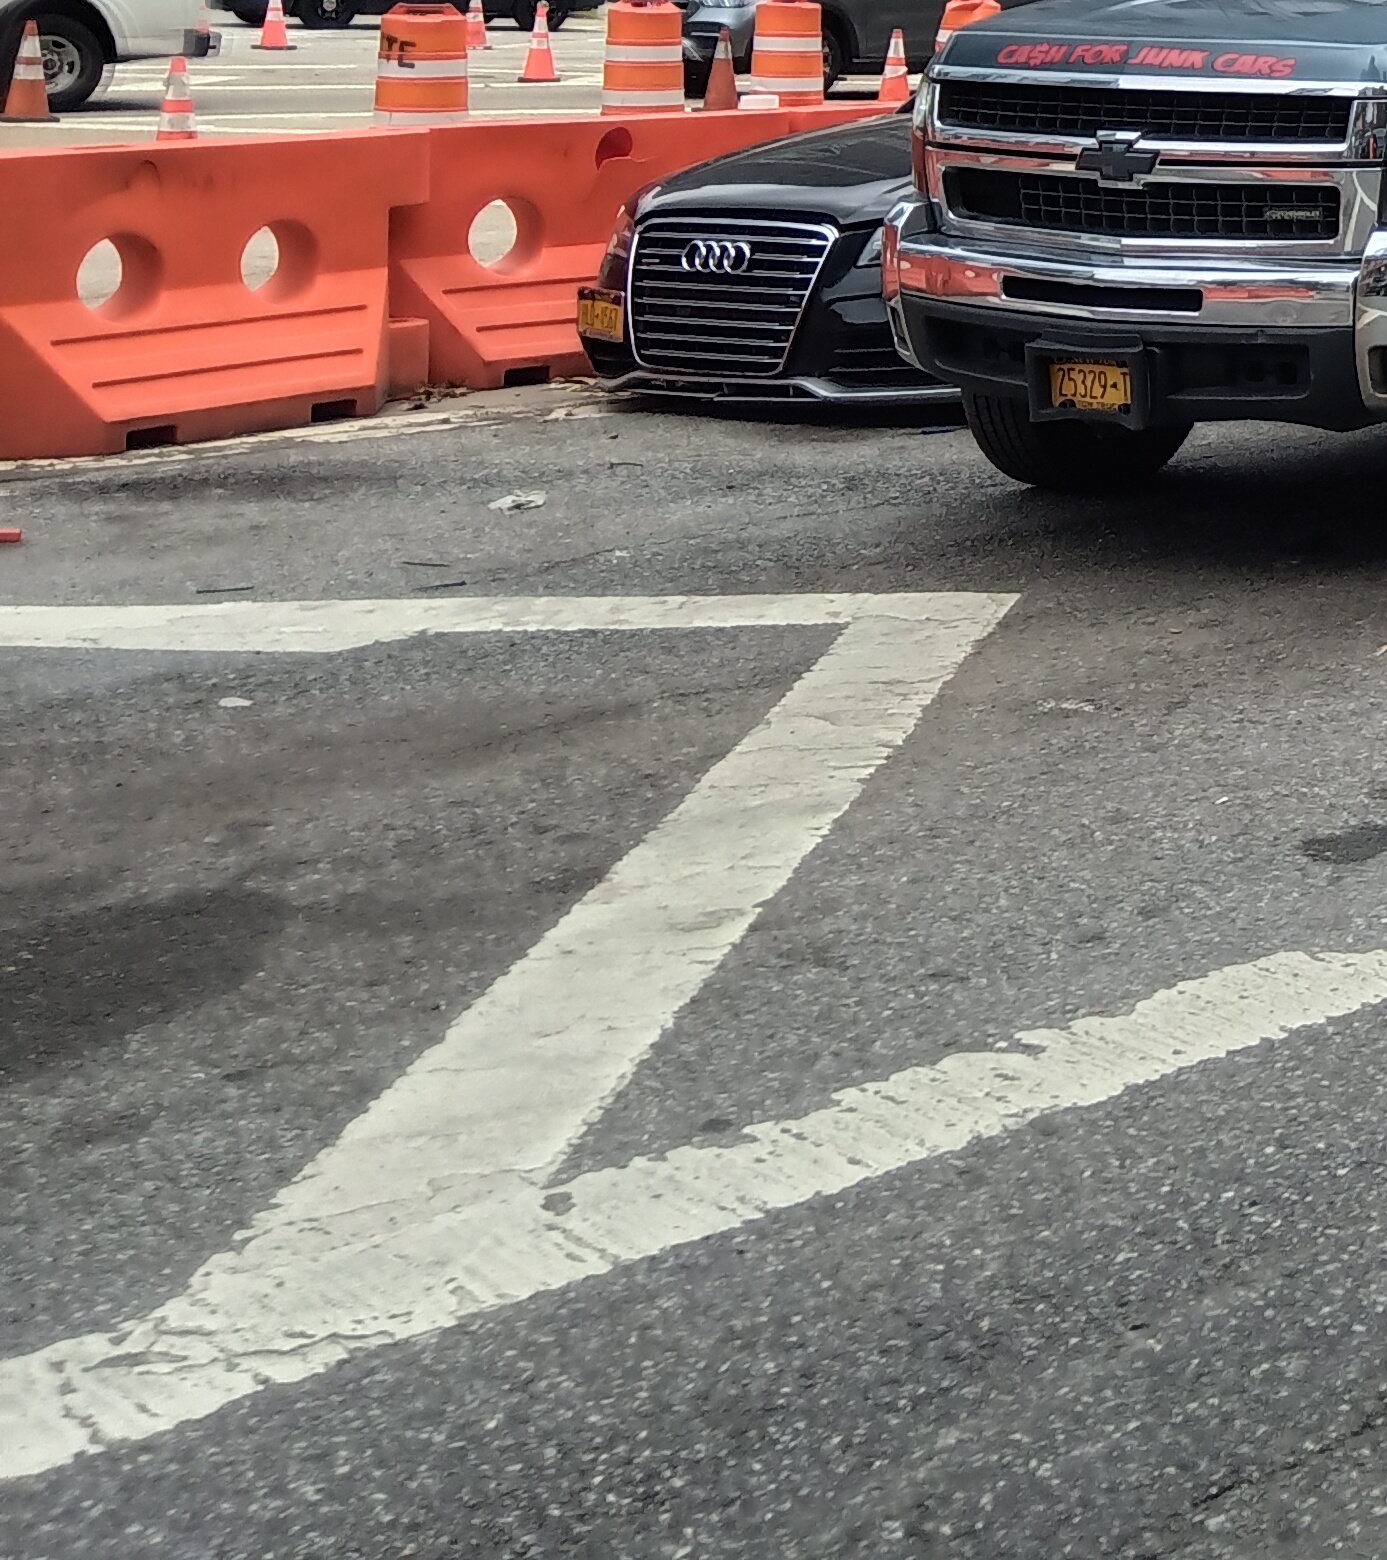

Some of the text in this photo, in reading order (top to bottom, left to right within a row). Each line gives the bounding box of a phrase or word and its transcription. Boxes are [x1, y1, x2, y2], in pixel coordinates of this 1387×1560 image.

[1066, 42, 1129, 65] FOR
[1126, 45, 1210, 70] JUNK
[1212, 52, 1297, 79] CARS
